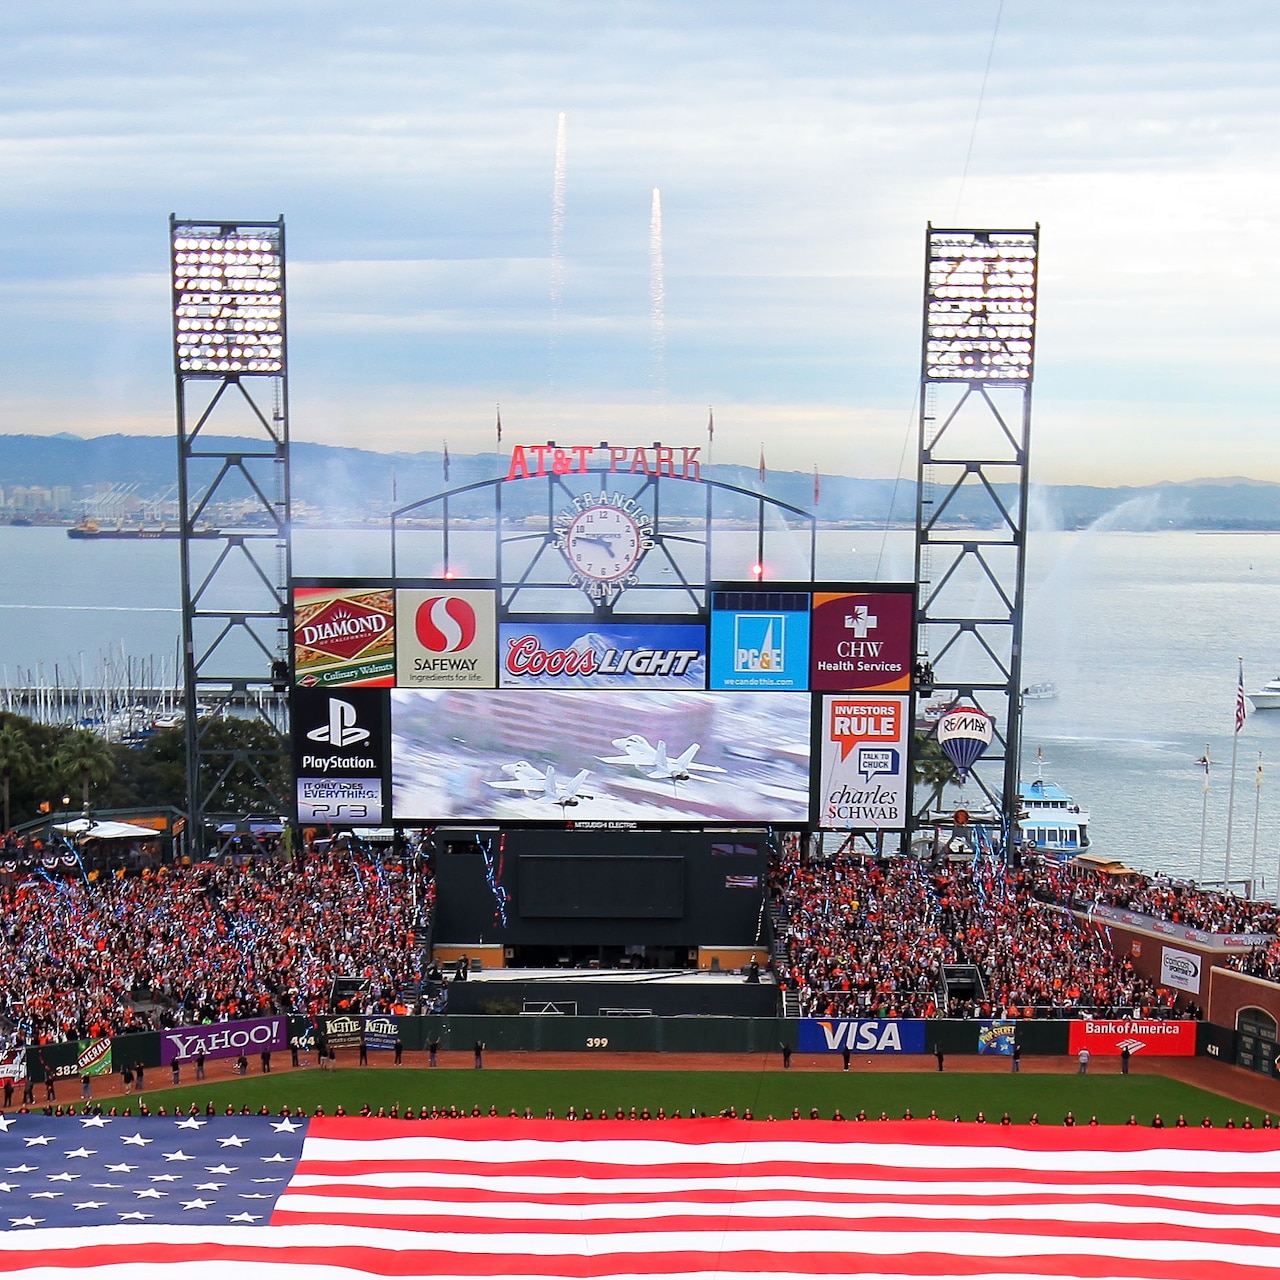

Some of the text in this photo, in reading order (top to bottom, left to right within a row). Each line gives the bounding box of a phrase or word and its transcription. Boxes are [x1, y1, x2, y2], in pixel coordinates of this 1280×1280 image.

[505, 445, 701, 482] AT&T PARK
[552, 490, 655, 550] SAN FRANCISCO
[568, 571, 639, 598] GIANTS
[302, 613, 387, 645] DIAMOND
[331, 632, 372, 644] CALIFORNIA
[506, 635, 699, 677] Coors LIGHT
[837, 641, 884, 658] CHW
[414, 658, 478, 671] SAFEWAY
[737, 648, 782, 670] PG&E
[817, 661, 902, 672] Health Services
[323, 663, 394, 682] Culinary Walnuts
[410, 673, 454, 685] Ingredients
[455, 673, 467, 682] for
[724, 677, 794, 686] wecandothis.com
[835, 705, 895, 715] INVESTORS
[835, 717, 895, 736] RULE
[944, 717, 987, 734] RE/MAX
[302, 755, 375, 772] PlayStation
[862, 760, 890, 769] CHUCK
[314, 782, 337, 790] ONLY
[304, 790, 378, 799] EVERYTHING.
[829, 784, 898, 805] charles
[312, 804, 368, 818] PS3
[828, 806, 898, 820] SCHWAB
[325, 1016, 362, 1034] KETTLE
[364, 1018, 399, 1034] KETTLE
[1085, 1022, 1180, 1034] Bank of America
[166, 1021, 280, 1059] YAHOO!
[290, 1035, 315, 1047] 404
[586, 1037, 609, 1048] 399
[817, 1021, 902, 1051] VISA
[79, 1037, 111, 1066] EMERALD
[1206, 1044, 1219, 1057] 421
[56, 1064, 78, 1076] 382
